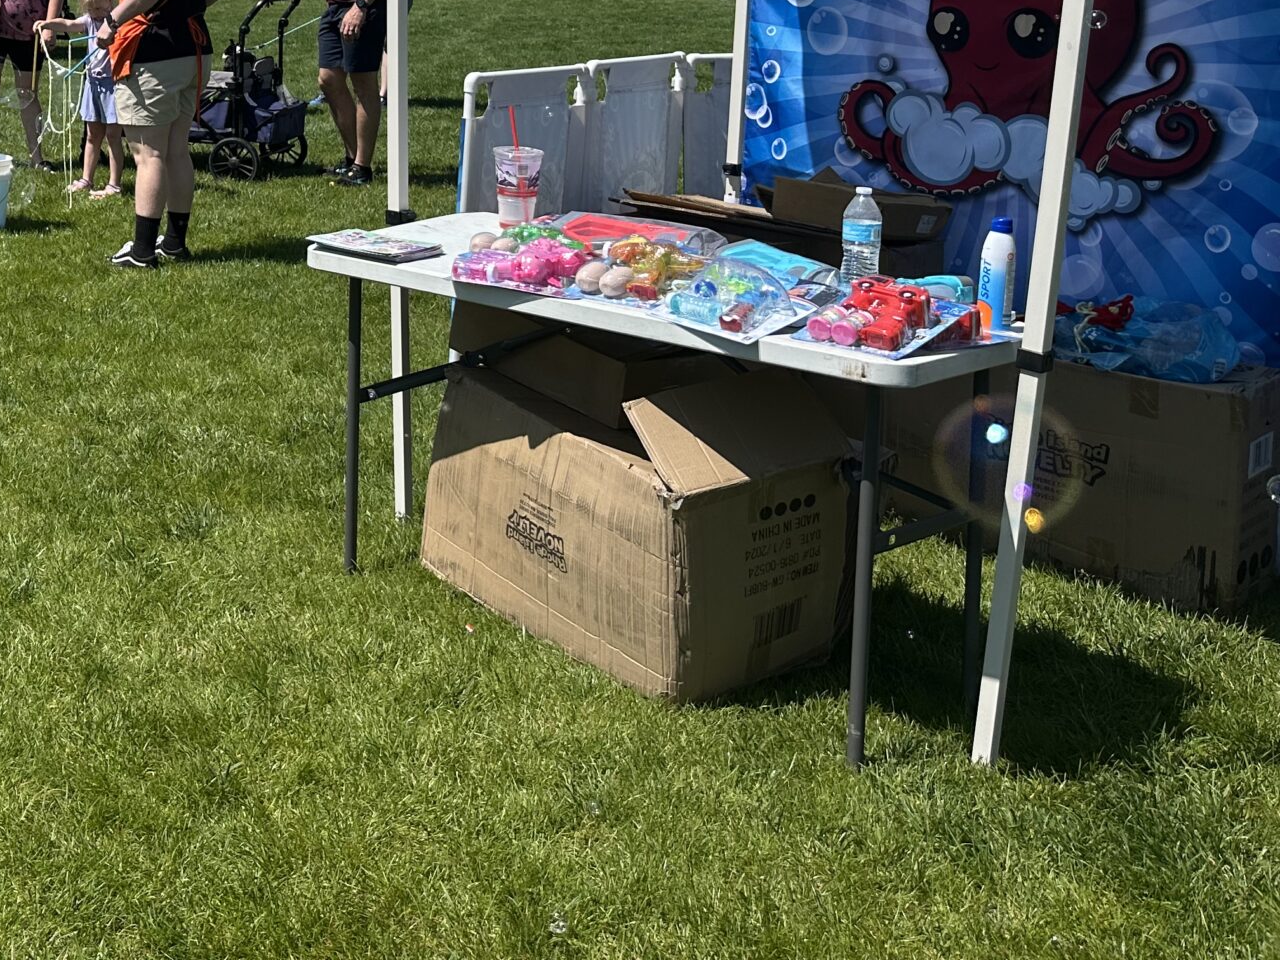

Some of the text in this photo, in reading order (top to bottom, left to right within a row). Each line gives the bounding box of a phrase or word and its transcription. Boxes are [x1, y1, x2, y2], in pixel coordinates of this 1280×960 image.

[980, 259, 992, 300] SPORT
[508, 508, 564, 555] NOVELTY
[751, 512, 820, 543] MADE IN CHINA
[800, 528, 821, 545] DATE
[535, 543, 568, 574] Rhode
